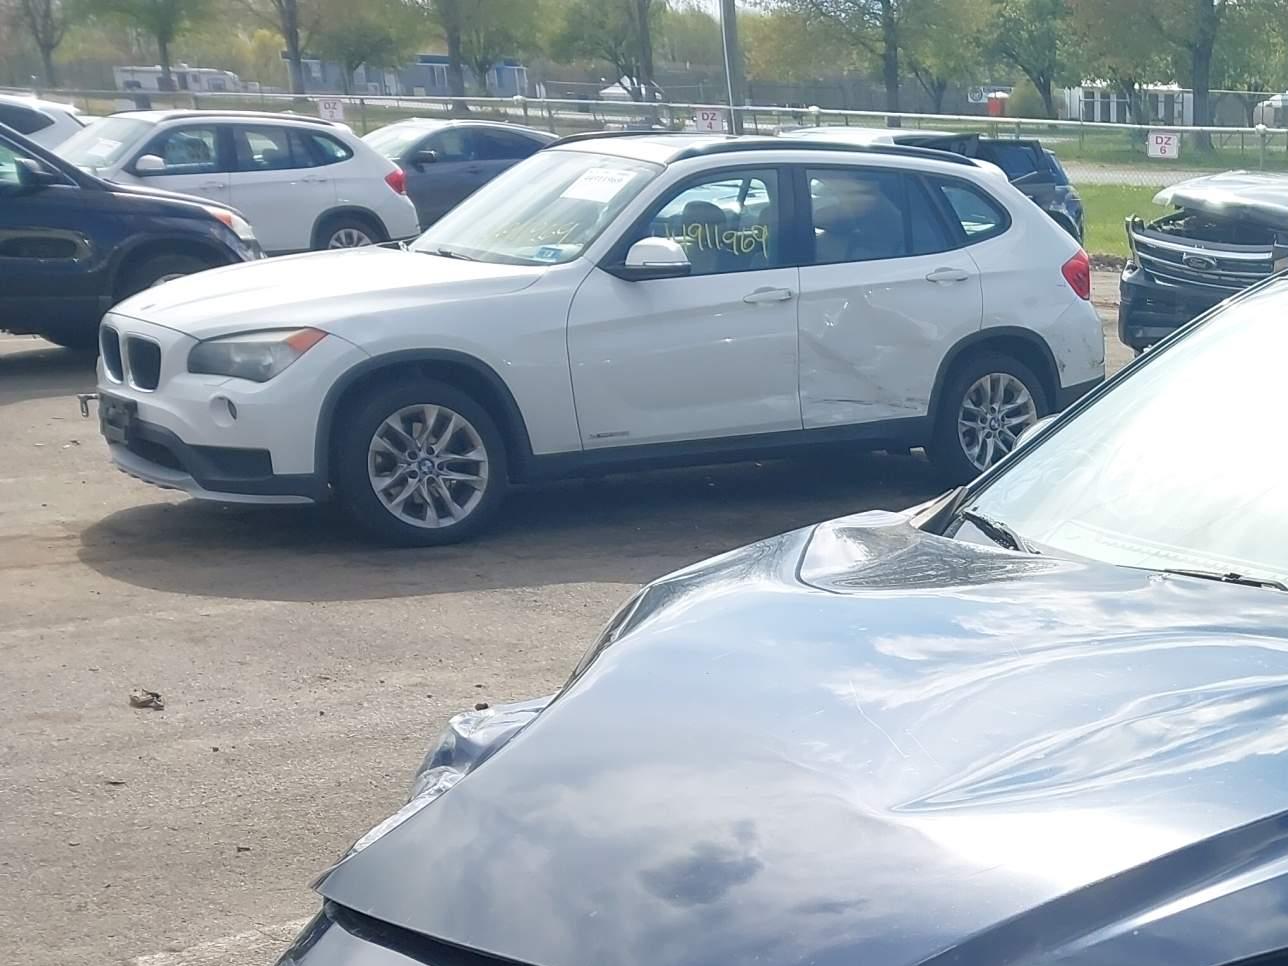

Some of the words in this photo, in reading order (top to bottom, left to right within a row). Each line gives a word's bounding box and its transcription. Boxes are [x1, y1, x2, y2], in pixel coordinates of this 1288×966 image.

[702, 112, 717, 121] DZ
[707, 121, 713, 130] 4
[1155, 135, 1172, 145] DZ
[1159, 146, 1167, 155] 6
